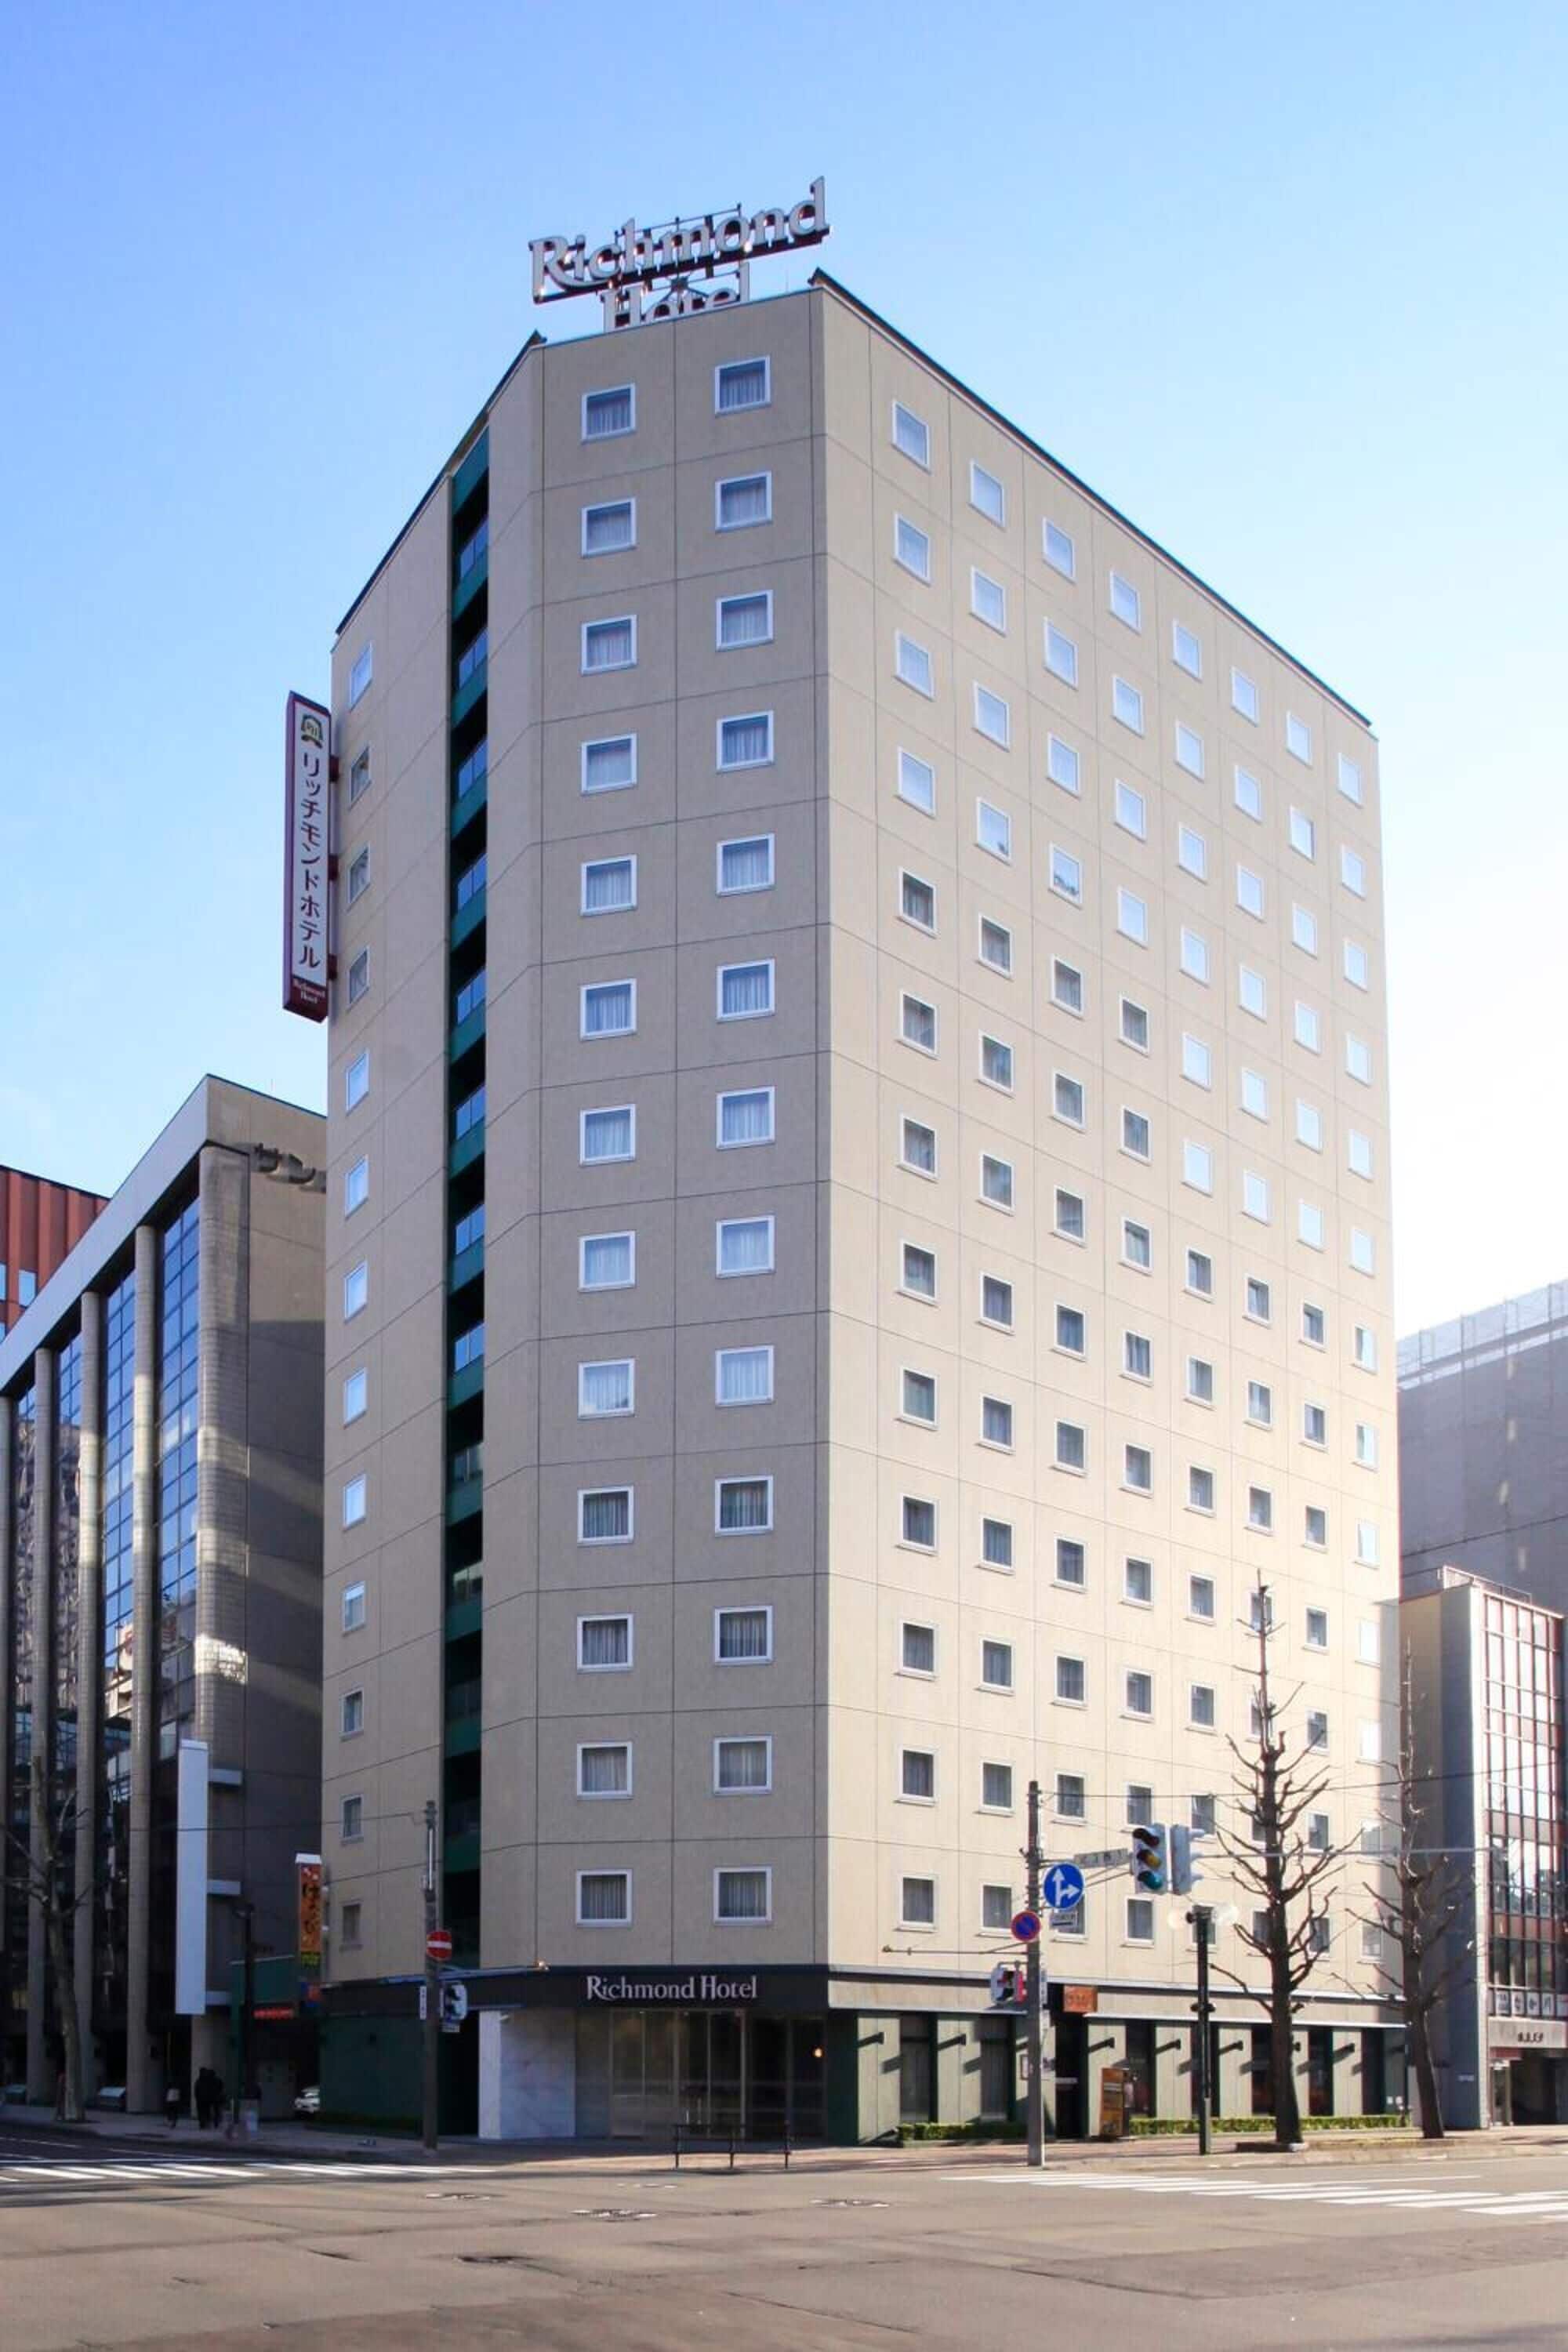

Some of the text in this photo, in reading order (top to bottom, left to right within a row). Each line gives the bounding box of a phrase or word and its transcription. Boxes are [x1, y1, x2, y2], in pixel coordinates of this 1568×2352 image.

[528, 176, 830, 304] Richmond
[599, 260, 750, 332] Hotel
[299, 751, 321, 969] リッチモンドホテル
[586, 1974, 757, 2001] Richmond Hotel
